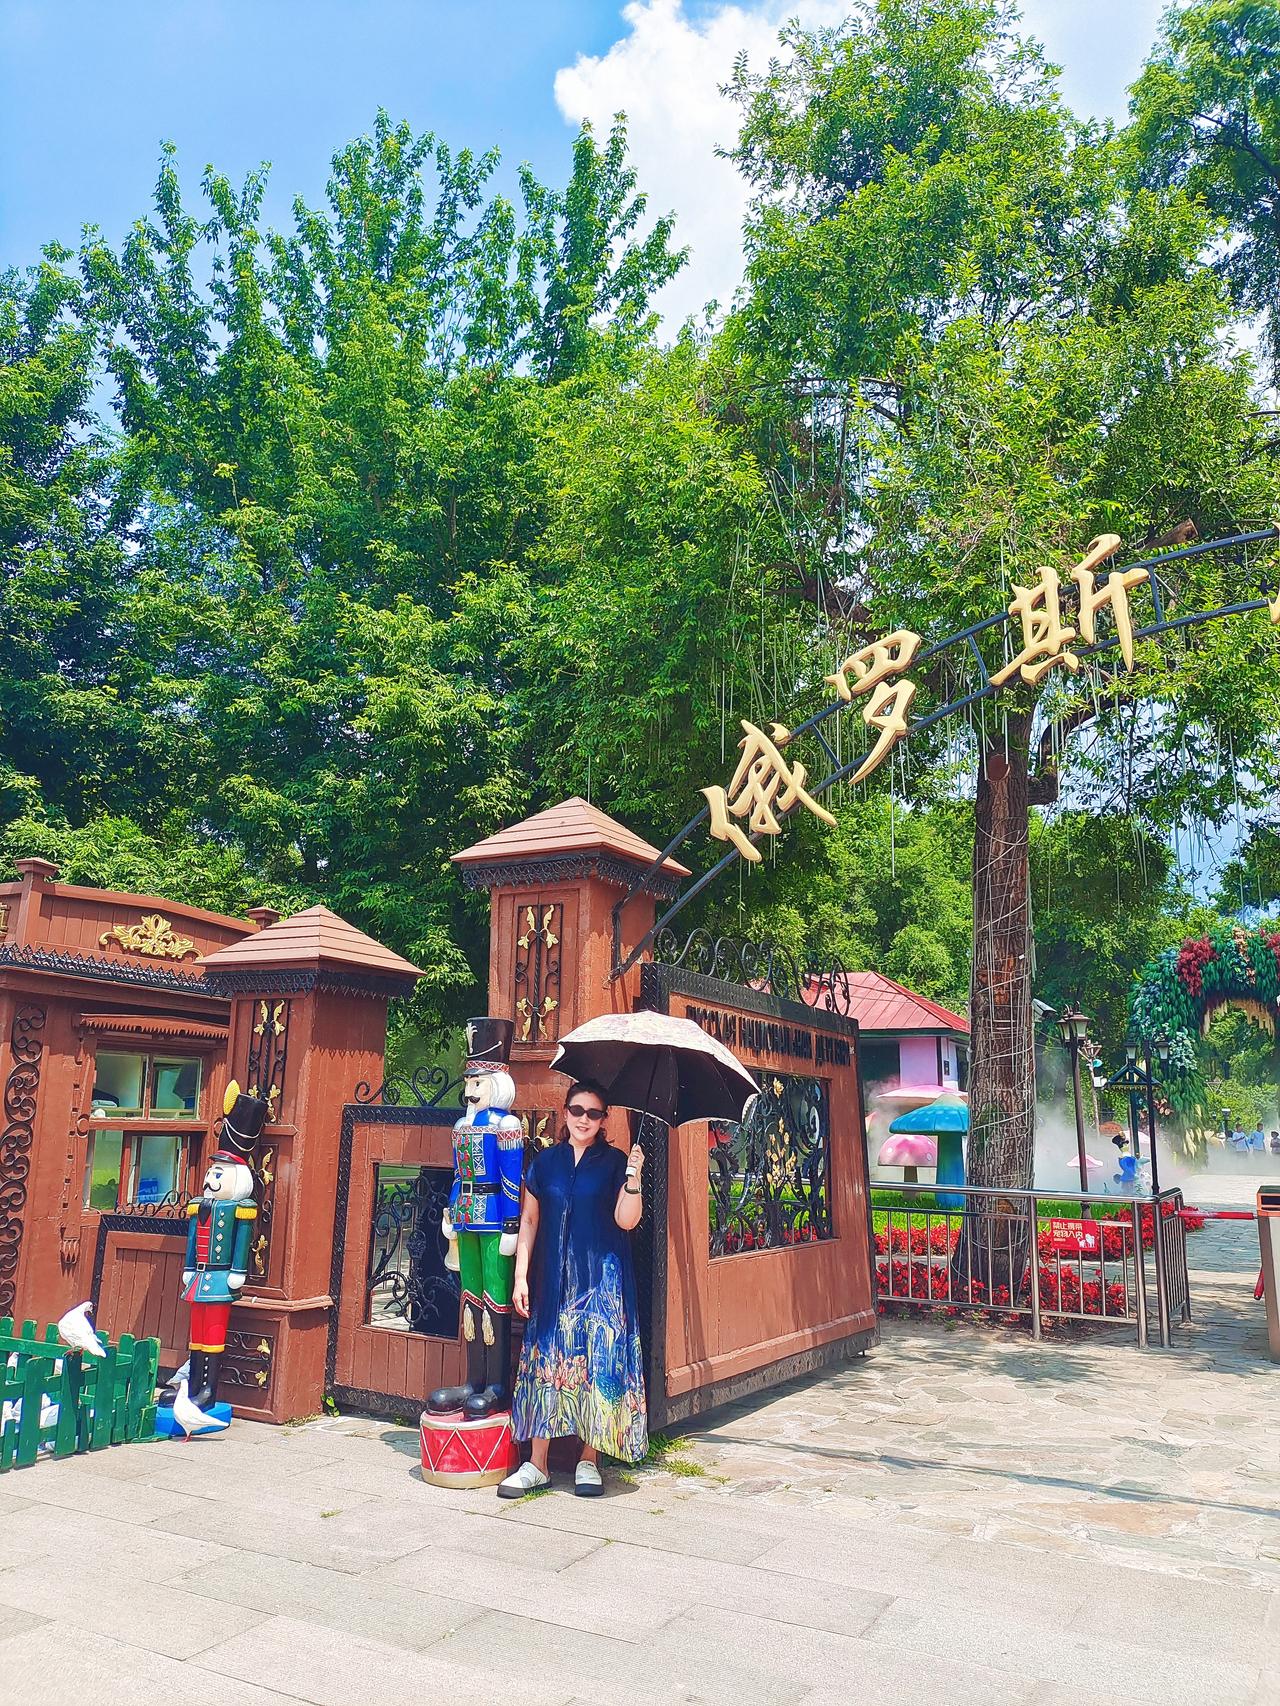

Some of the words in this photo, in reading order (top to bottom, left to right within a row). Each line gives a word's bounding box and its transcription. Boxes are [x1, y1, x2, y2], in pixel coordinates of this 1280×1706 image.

[698, 521, 1280, 862] 俄罗斯
[1052, 1230, 1083, 1239] 宠物入内
